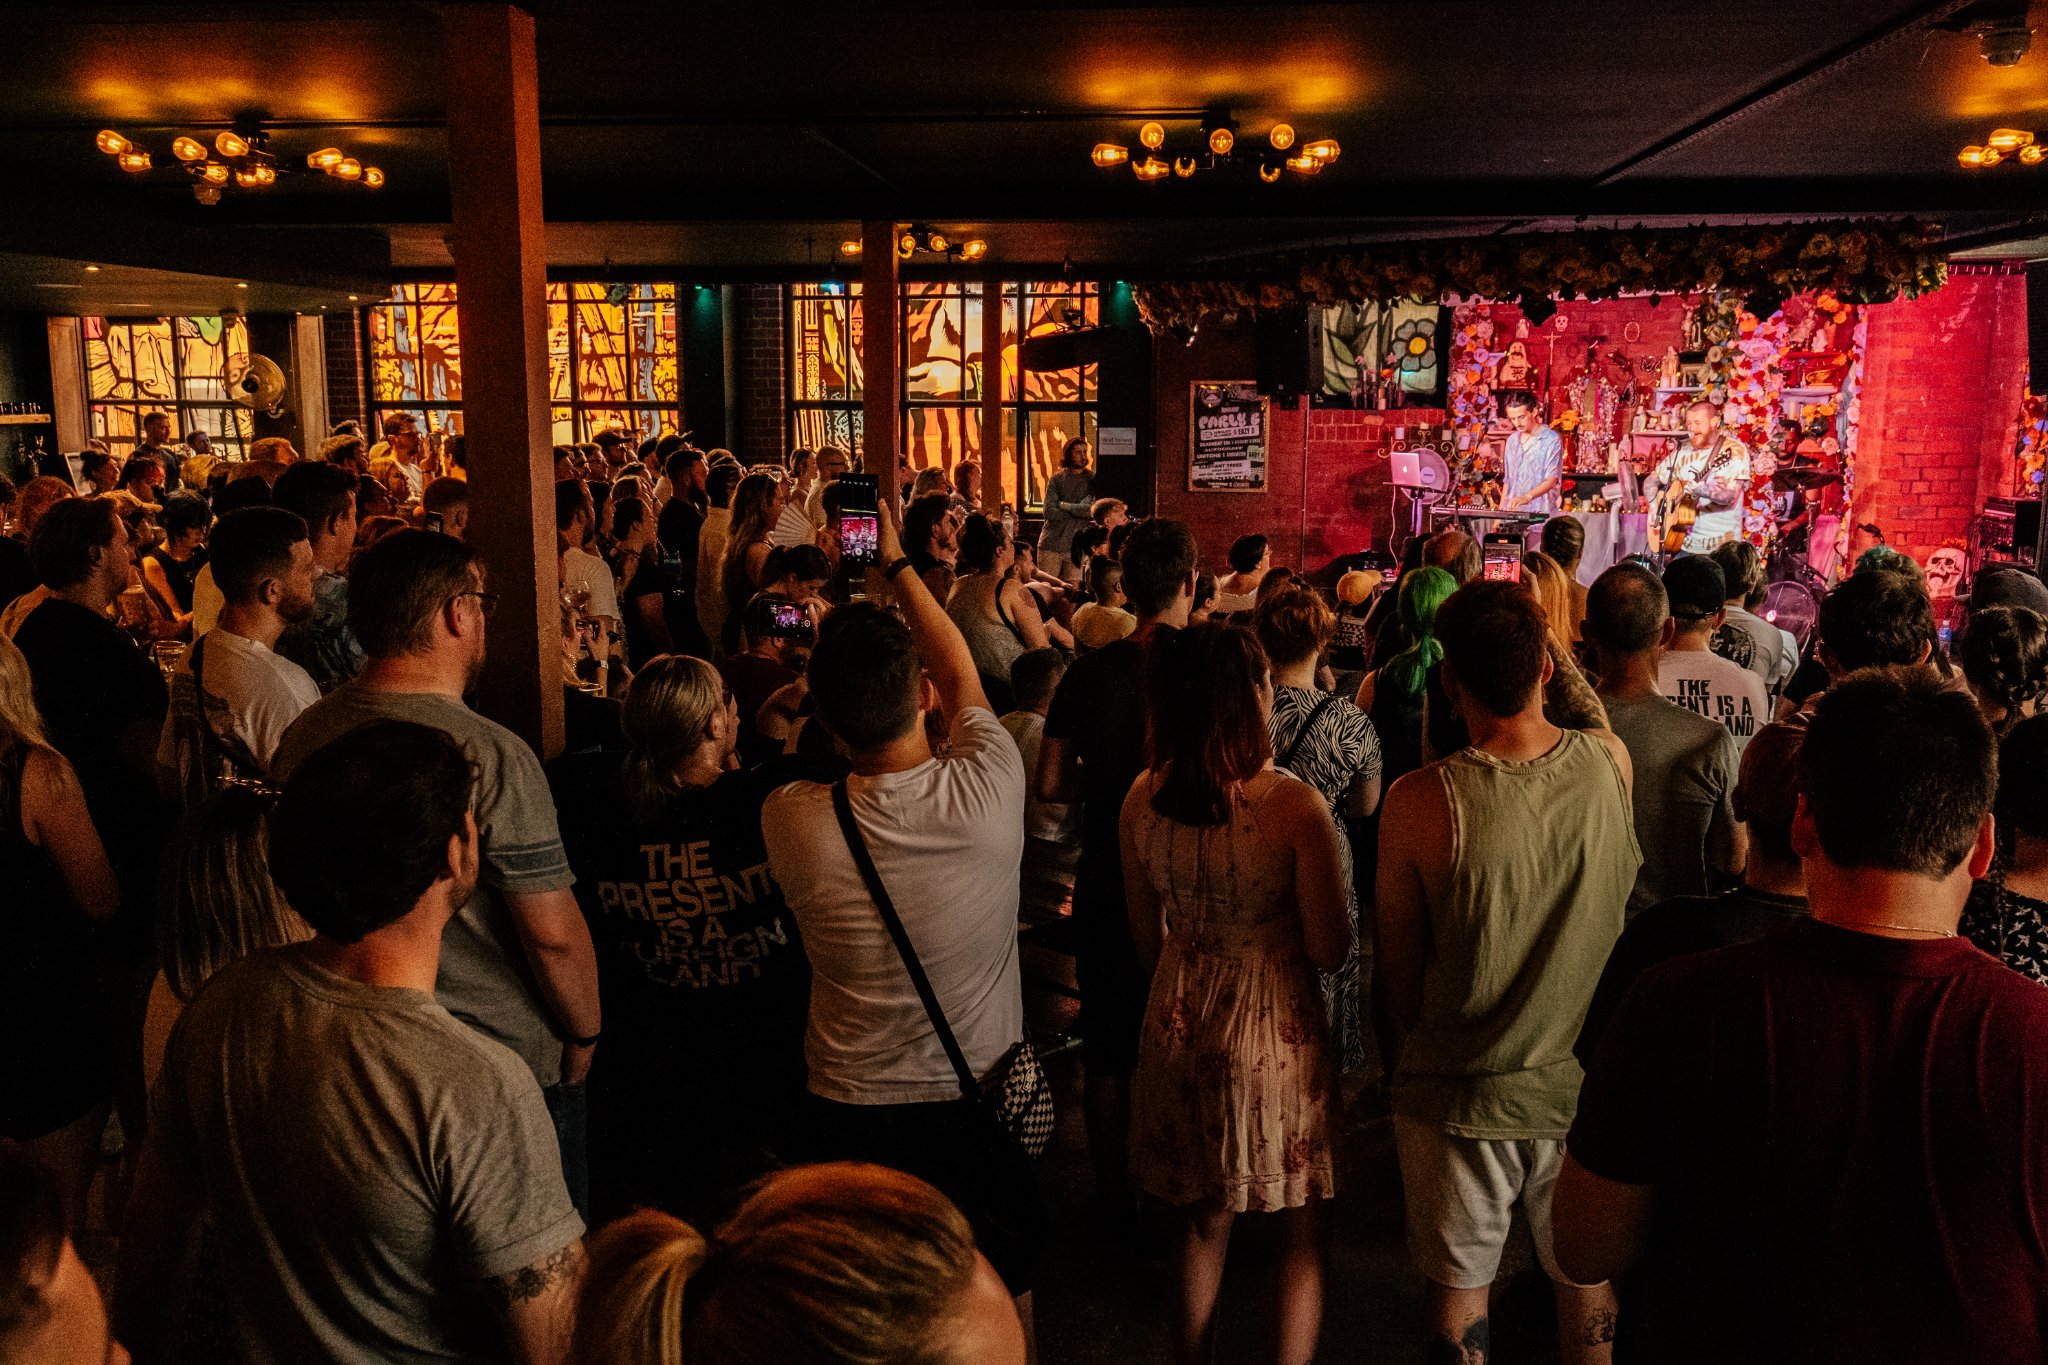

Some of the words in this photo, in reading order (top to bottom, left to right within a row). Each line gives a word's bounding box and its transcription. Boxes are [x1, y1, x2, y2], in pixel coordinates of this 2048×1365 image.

[1677, 679, 1711, 695] THE
[1717, 696, 1735, 716] IS
[1742, 697, 1752, 716] A
[1713, 716, 1754, 736] AND
[640, 840, 714, 880] THE
[599, 862, 772, 921] PRESENT
[656, 919, 694, 947] IS
[702, 915, 727, 946] A
